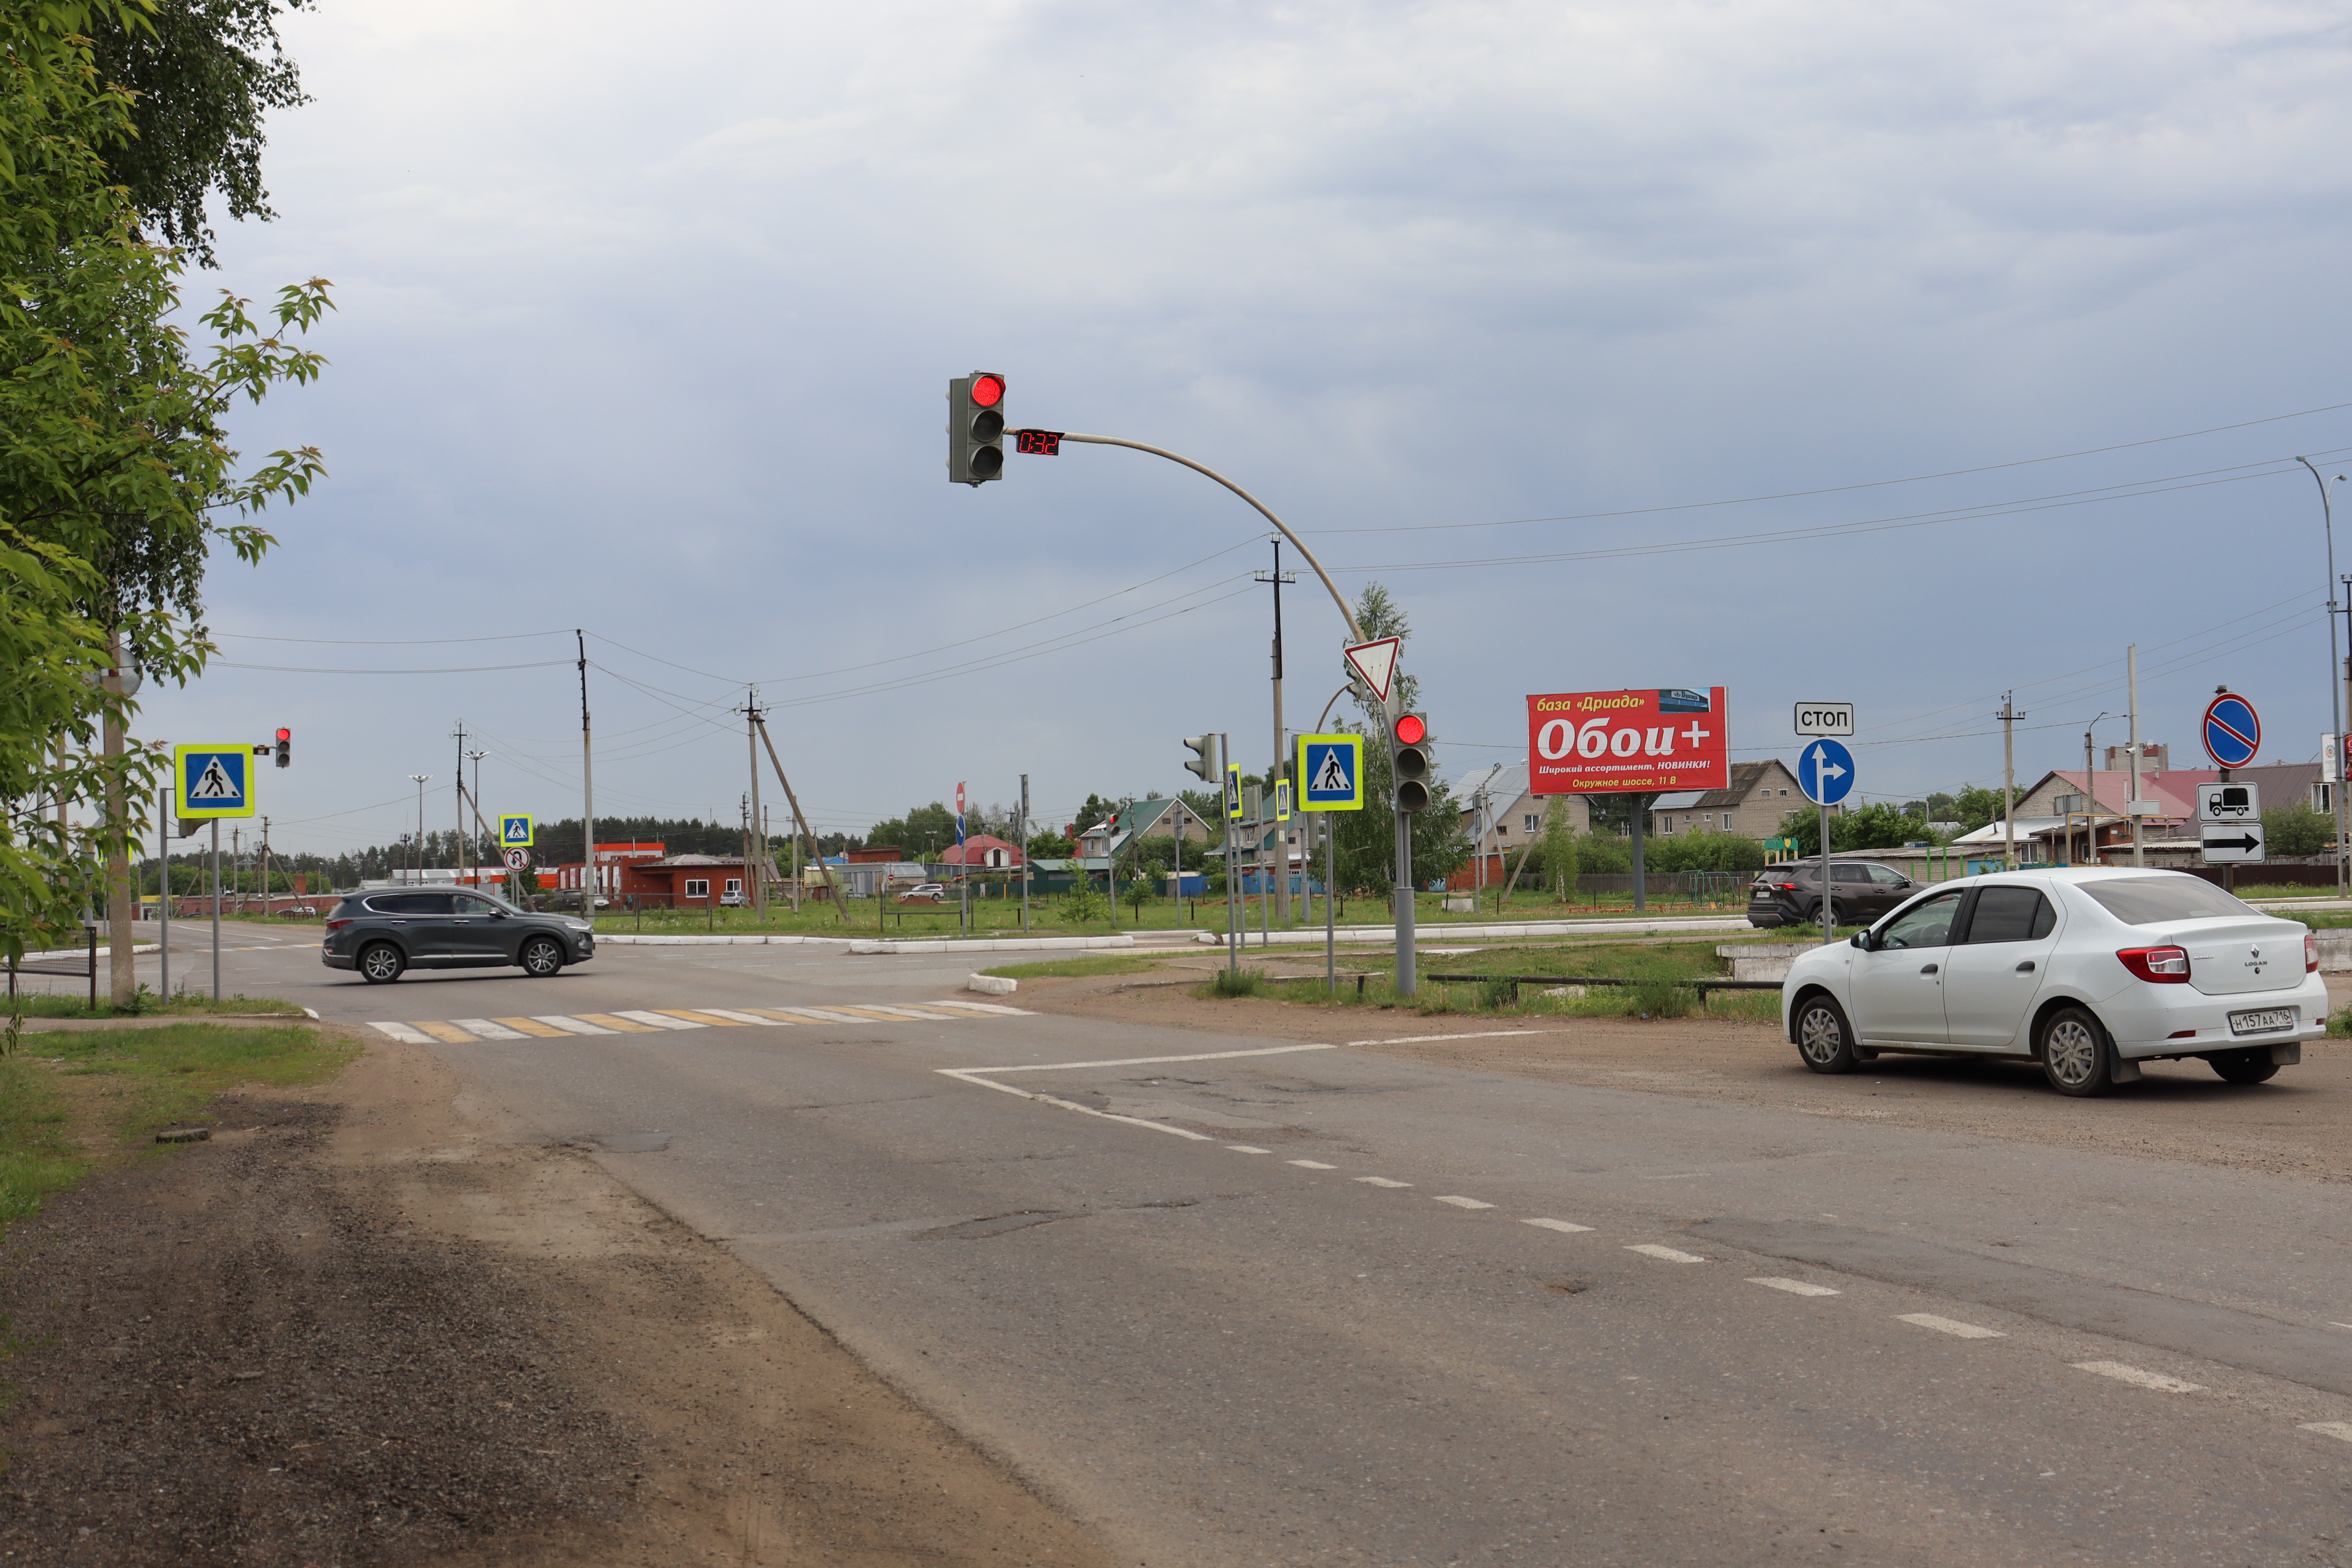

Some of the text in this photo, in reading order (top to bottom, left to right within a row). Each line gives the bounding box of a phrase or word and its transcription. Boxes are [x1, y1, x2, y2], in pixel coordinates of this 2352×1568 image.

[1019, 432, 1058, 455] 0:32
[1537, 695, 1645, 711] база «Дриада»
[1802, 711, 1847, 726] СТОП
[1539, 760, 1711, 775] Широкий ассортимент, НОВИНКИ!
[1572, 779, 1619, 789] Окружное
[1622, 778, 1655, 786] шоссе,
[1659, 777, 1666, 785] 11
